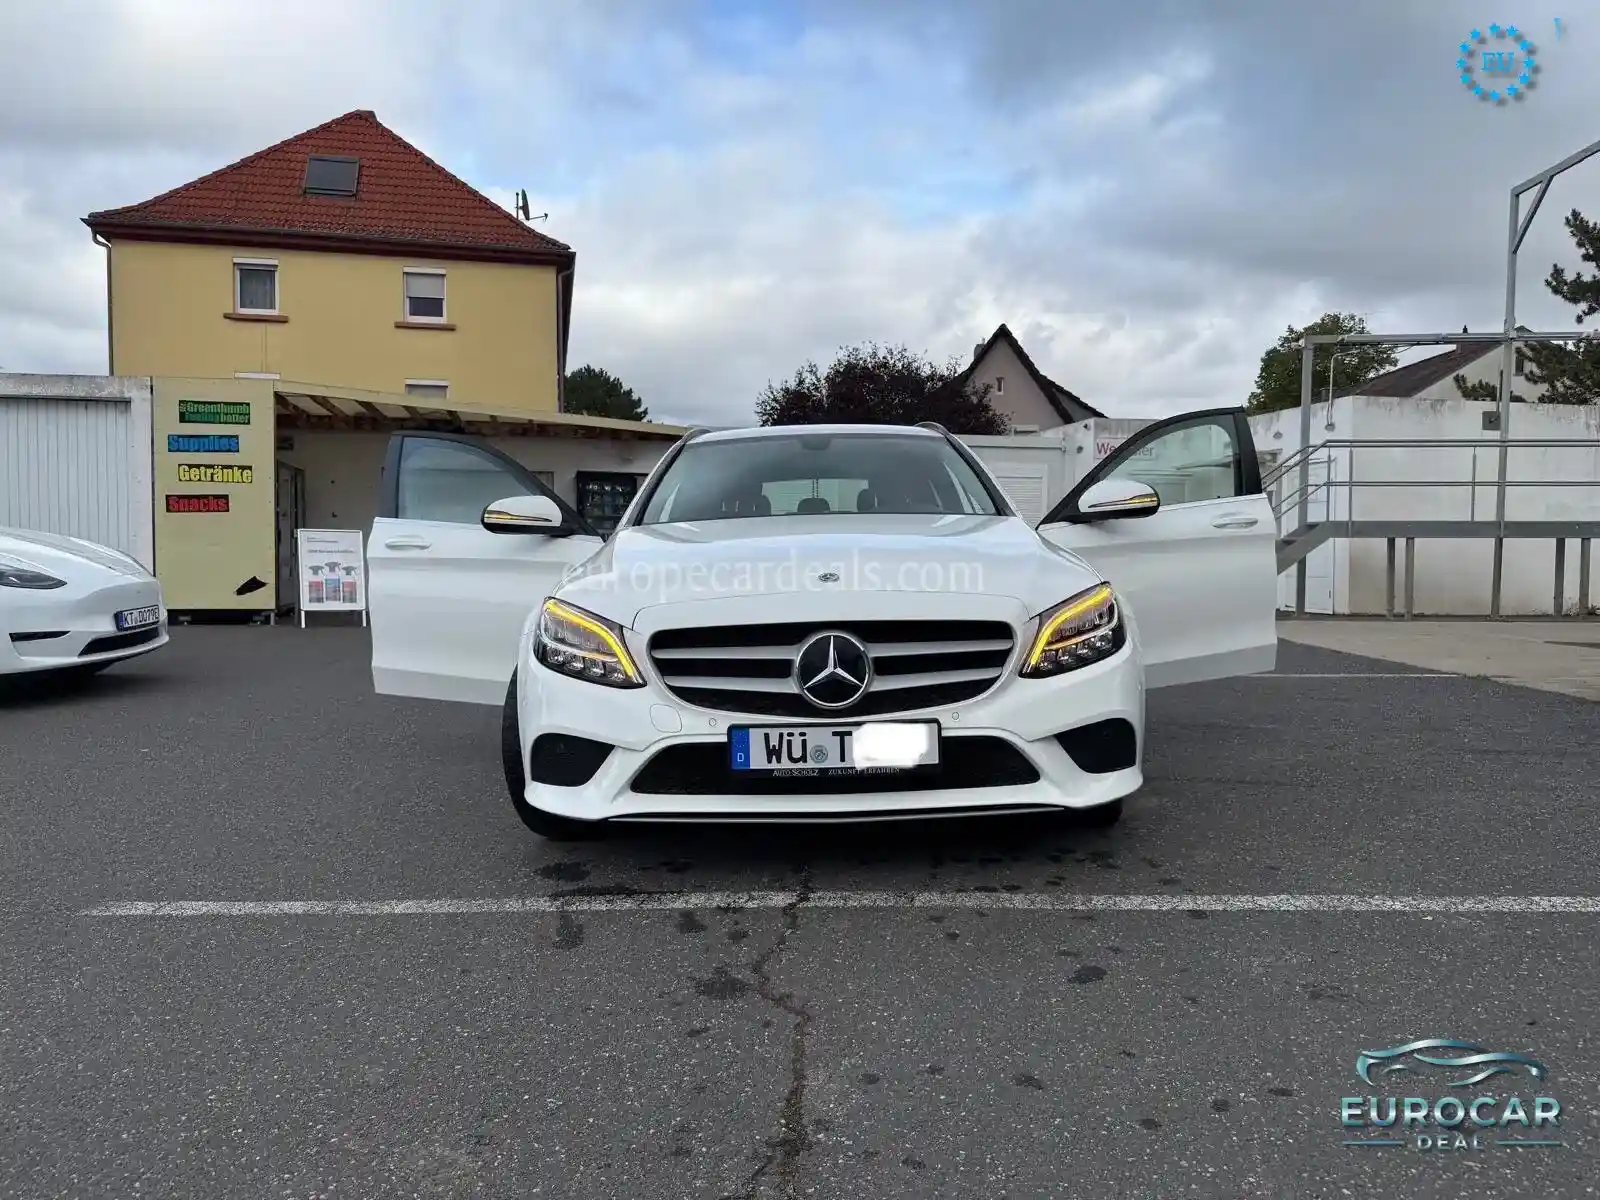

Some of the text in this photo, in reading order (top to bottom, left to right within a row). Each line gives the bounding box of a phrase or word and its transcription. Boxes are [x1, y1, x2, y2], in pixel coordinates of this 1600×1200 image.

[169, 435, 239, 451] Supplies
[179, 464, 252, 483] Getränke
[168, 496, 228, 512] Snacks
[123, 612, 134, 626] KT
[763, 731, 808, 764] WÜ
[736, 752, 745, 762] D
